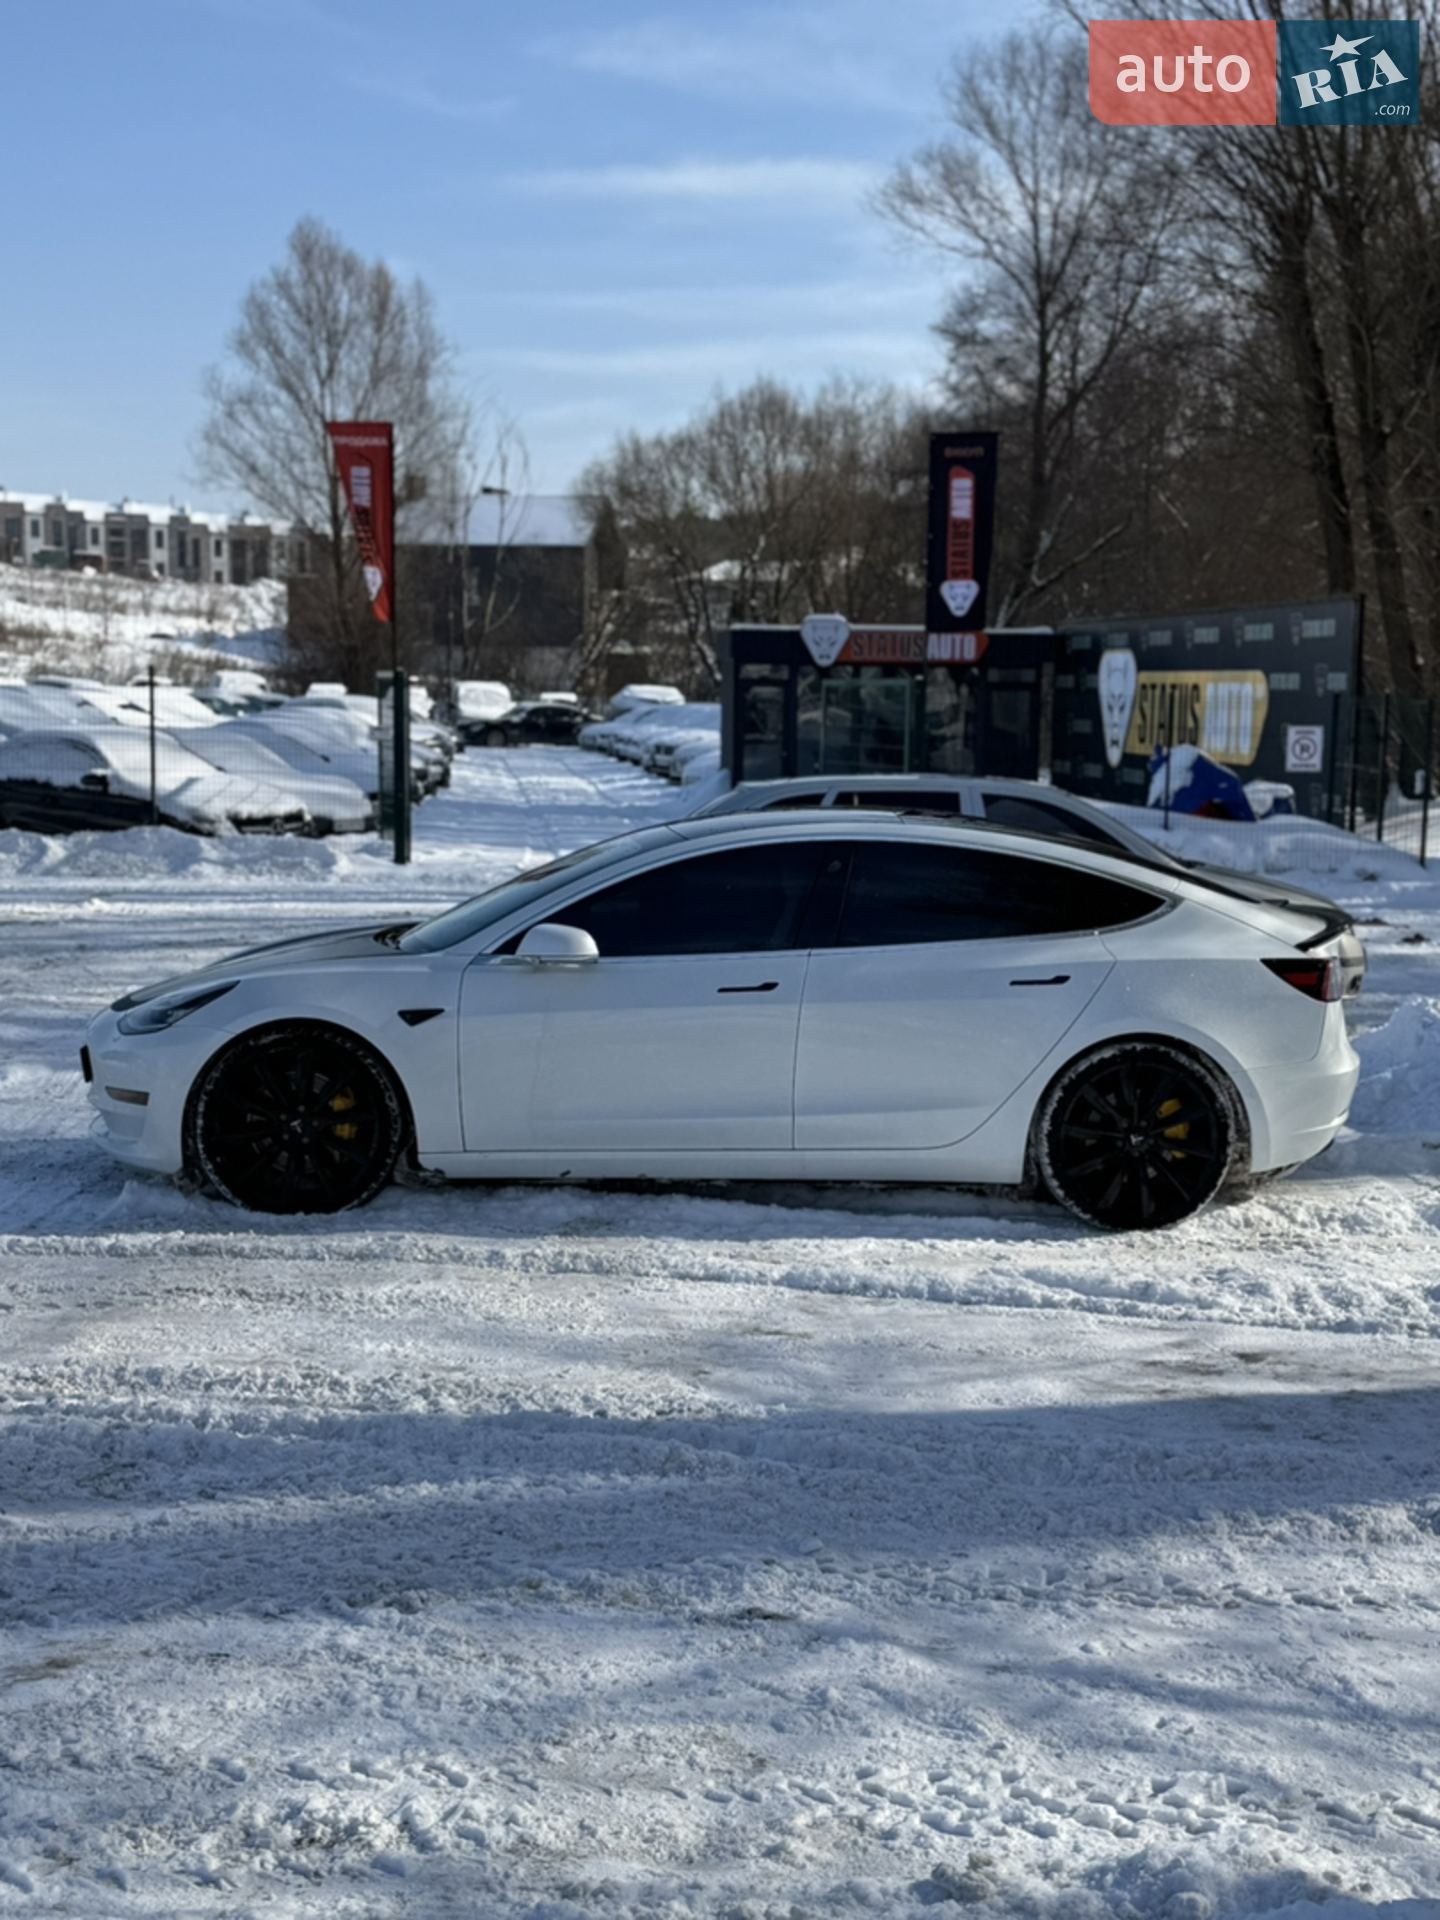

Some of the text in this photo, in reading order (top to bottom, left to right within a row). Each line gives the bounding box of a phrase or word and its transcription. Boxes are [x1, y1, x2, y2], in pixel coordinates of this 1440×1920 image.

[951, 519, 970, 579] STATUS
[852, 633, 977, 660] STATUS AUTO
[1138, 682, 1253, 754] STATUS AUTO
